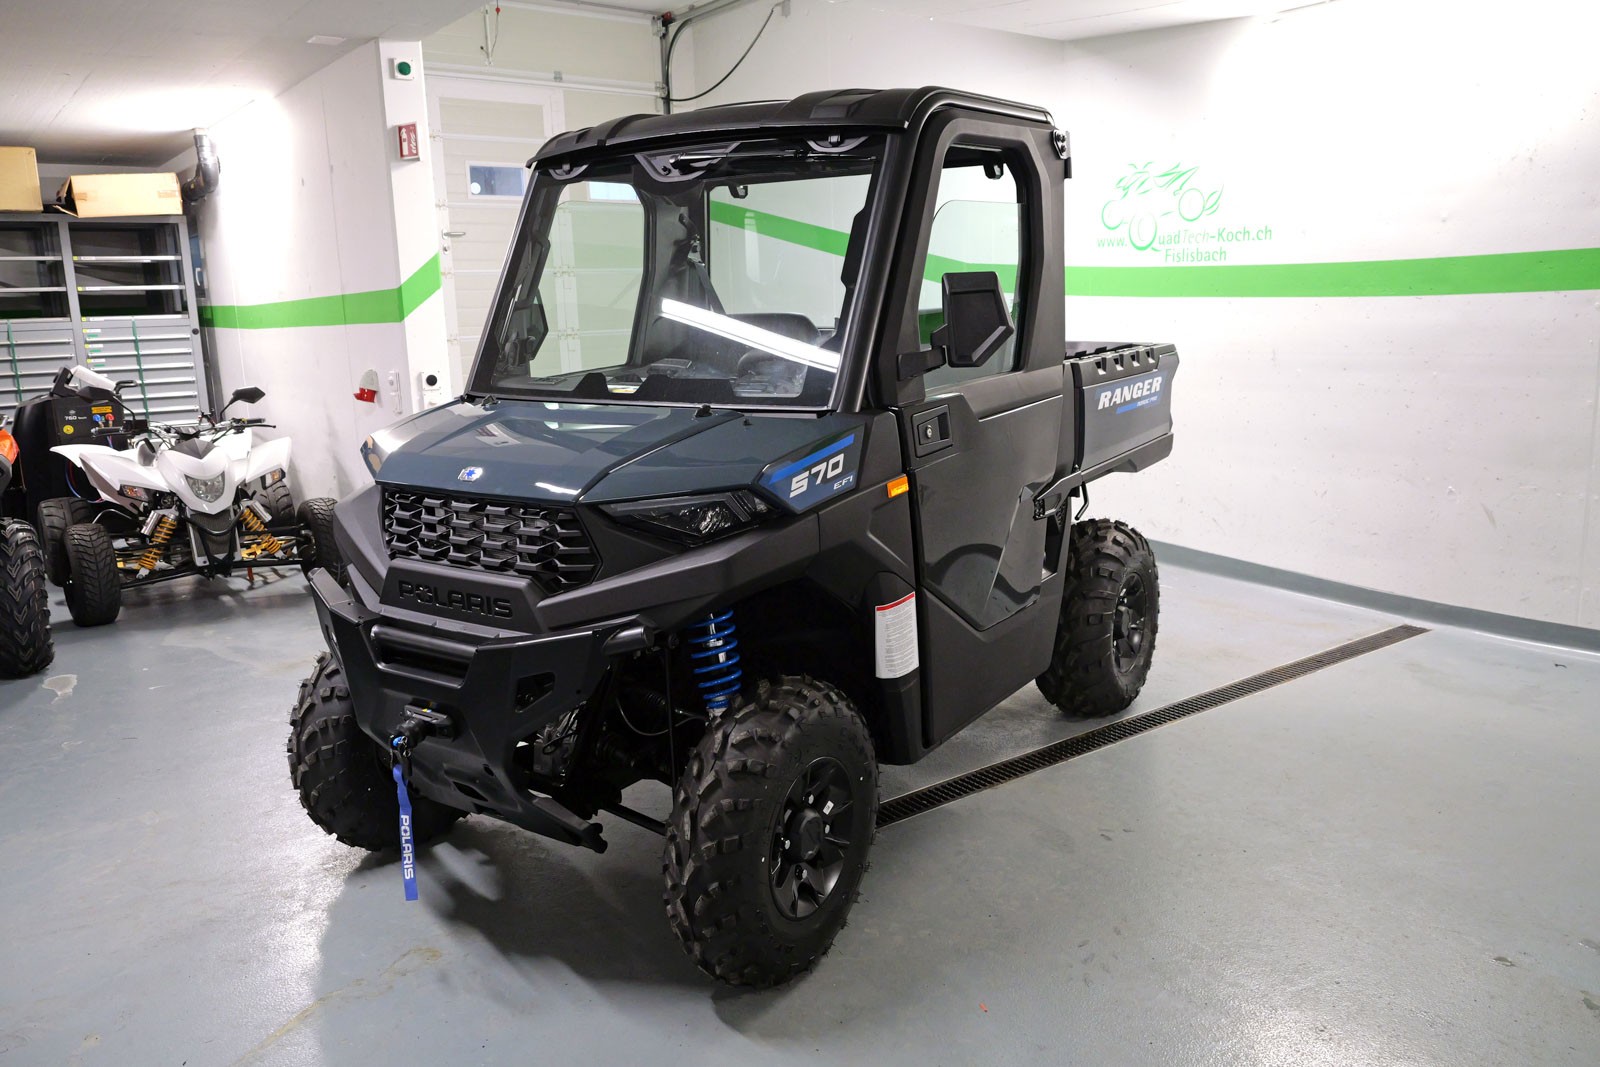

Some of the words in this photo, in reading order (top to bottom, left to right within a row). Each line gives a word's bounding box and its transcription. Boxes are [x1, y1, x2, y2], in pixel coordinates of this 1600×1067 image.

[1165, 247, 1227, 262] Fislisbach
[1098, 377, 1162, 410] RANGER
[789, 453, 844, 498] 570
[833, 475, 853, 490] EFI
[399, 581, 513, 619] POLARIS
[401, 815, 414, 879] POLARIS
